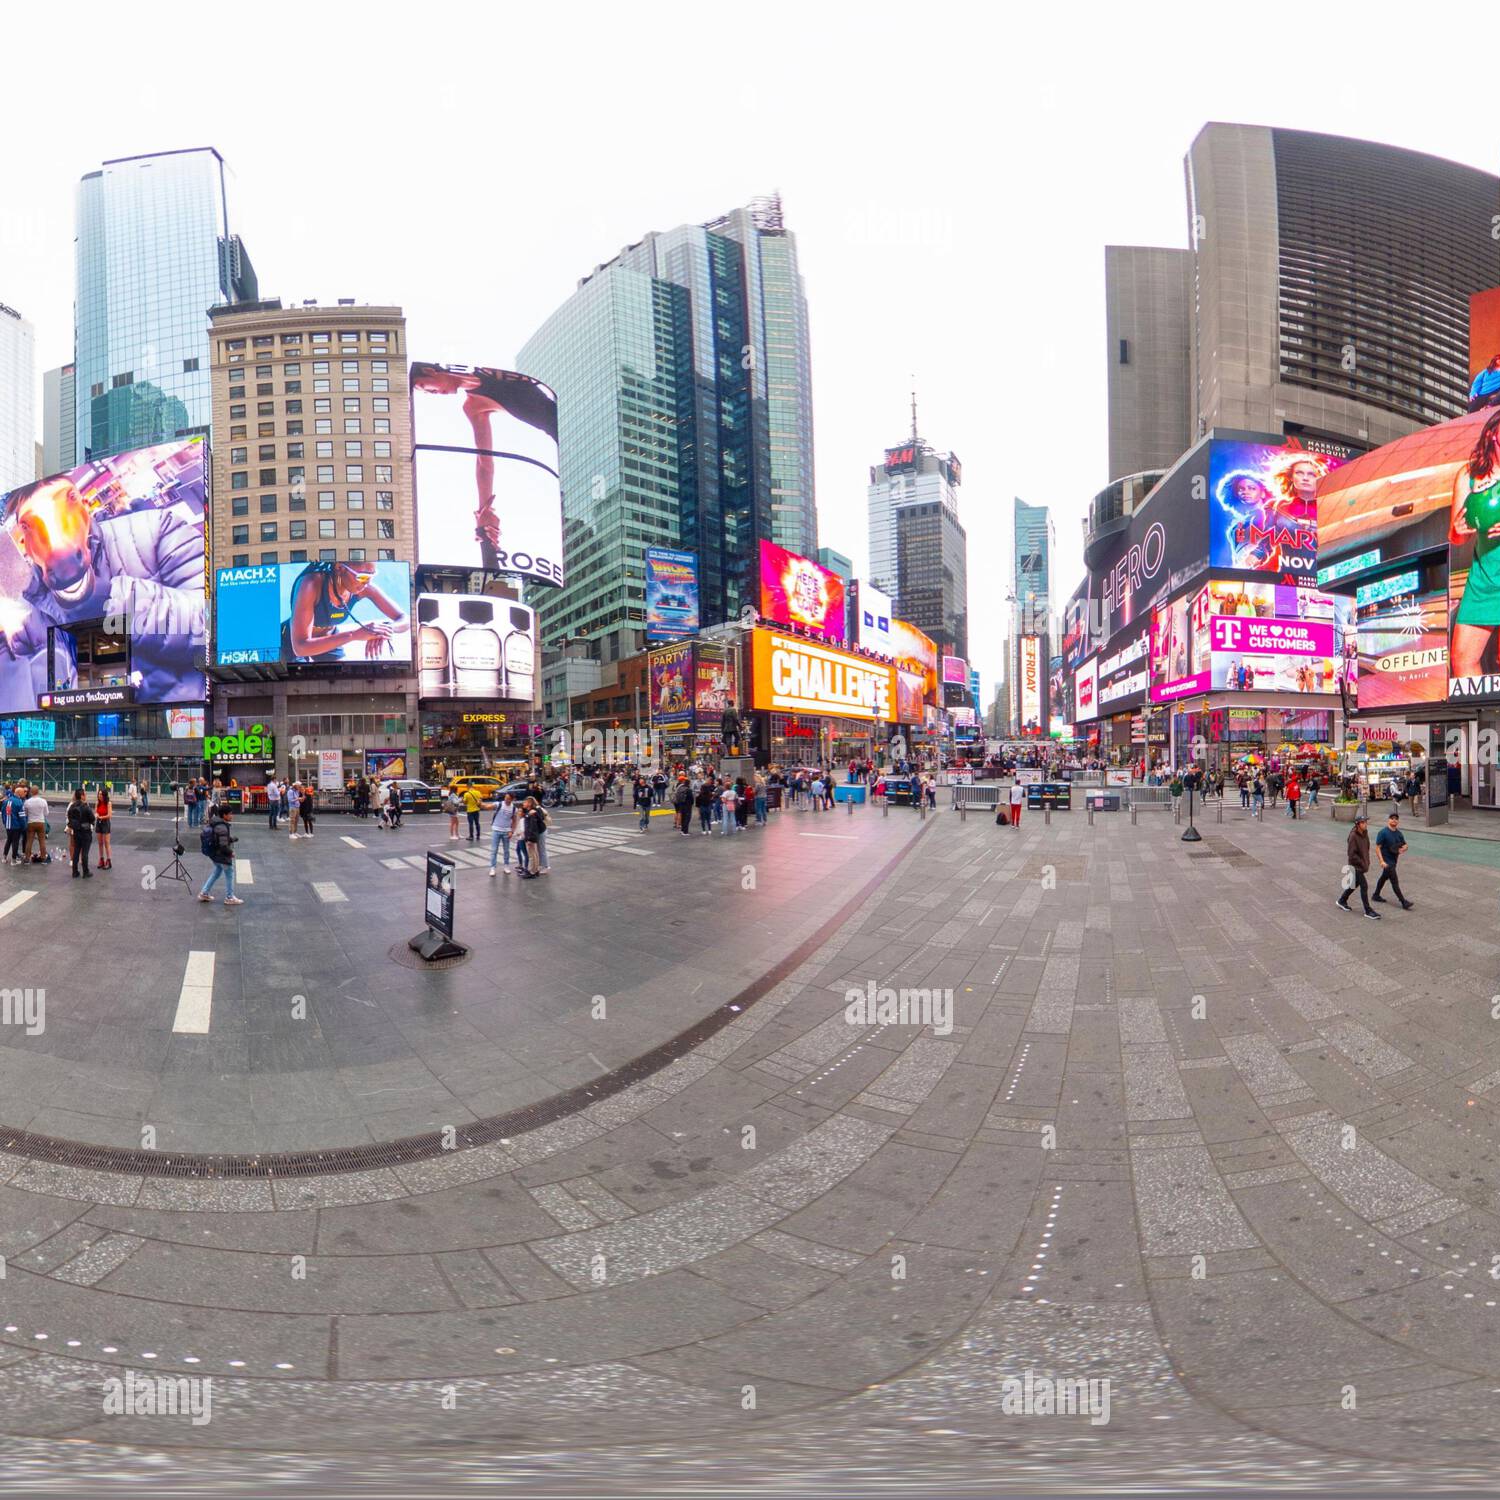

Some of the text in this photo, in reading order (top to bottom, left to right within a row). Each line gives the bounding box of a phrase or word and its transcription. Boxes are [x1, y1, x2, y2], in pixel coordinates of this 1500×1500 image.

[1308, 440, 1352, 454] MARRIOTT
[1308, 447, 1347, 459] MARQUIS
[1250, 525, 1317, 552] MAR
[498, 550, 563, 586] ROSE
[1102, 521, 1166, 613] HERO
[1278, 555, 1315, 570] NOV
[220, 567, 277, 582] MACH X
[1216, 619, 1241, 649] T
[1249, 624, 1308, 639] WE OUR
[1249, 637, 1316, 651] CUSTOMERS
[220, 650, 260, 664] HOKA
[653, 649, 689, 668] PARTY!
[1381, 649, 1449, 670] OFFLINE
[1026, 652, 1036, 693] FRIDAY
[1398, 674, 1406, 682] by
[54, 691, 124, 706] tag us on Instagram
[463, 714, 506, 723] EXPRESS
[204, 723, 263, 760] pelé
[1362, 727, 1398, 741] Mobile
